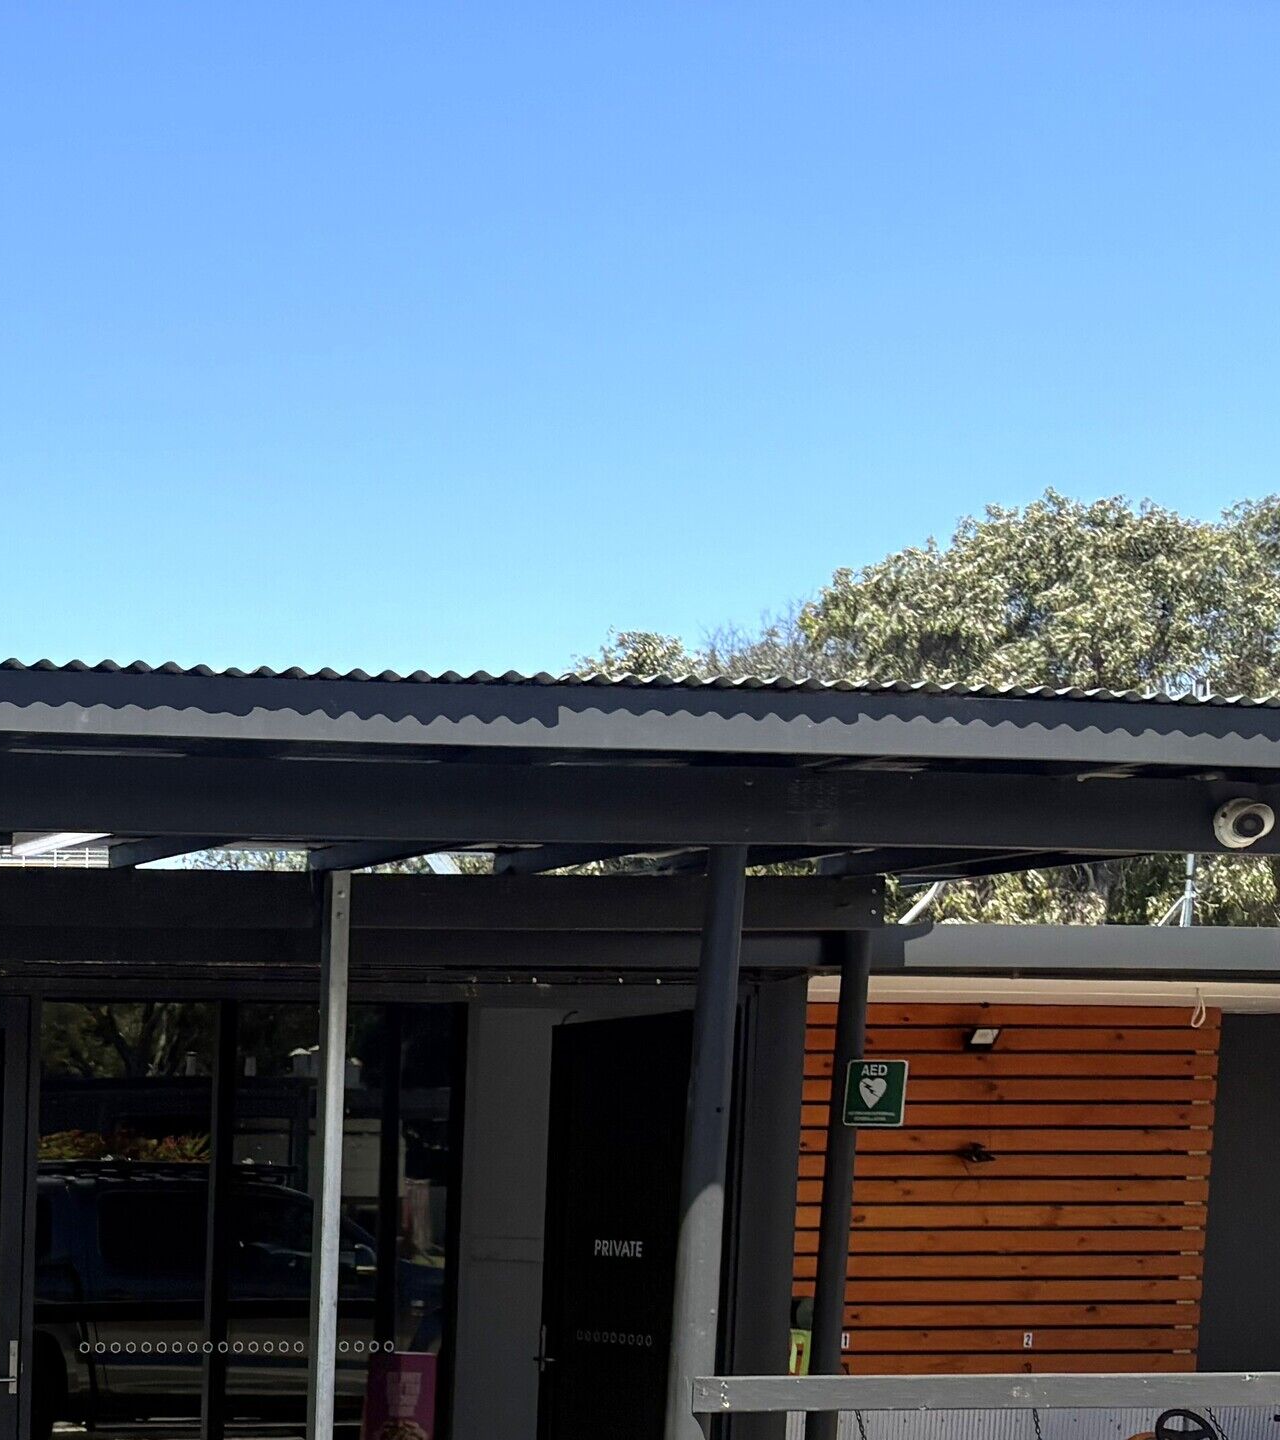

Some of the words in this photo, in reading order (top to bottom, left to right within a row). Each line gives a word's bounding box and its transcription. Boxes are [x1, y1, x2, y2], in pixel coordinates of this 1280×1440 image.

[861, 1064, 888, 1076] AED
[594, 1239, 643, 1257] PRIVATE
[1025, 1335, 1031, 1346] 2
